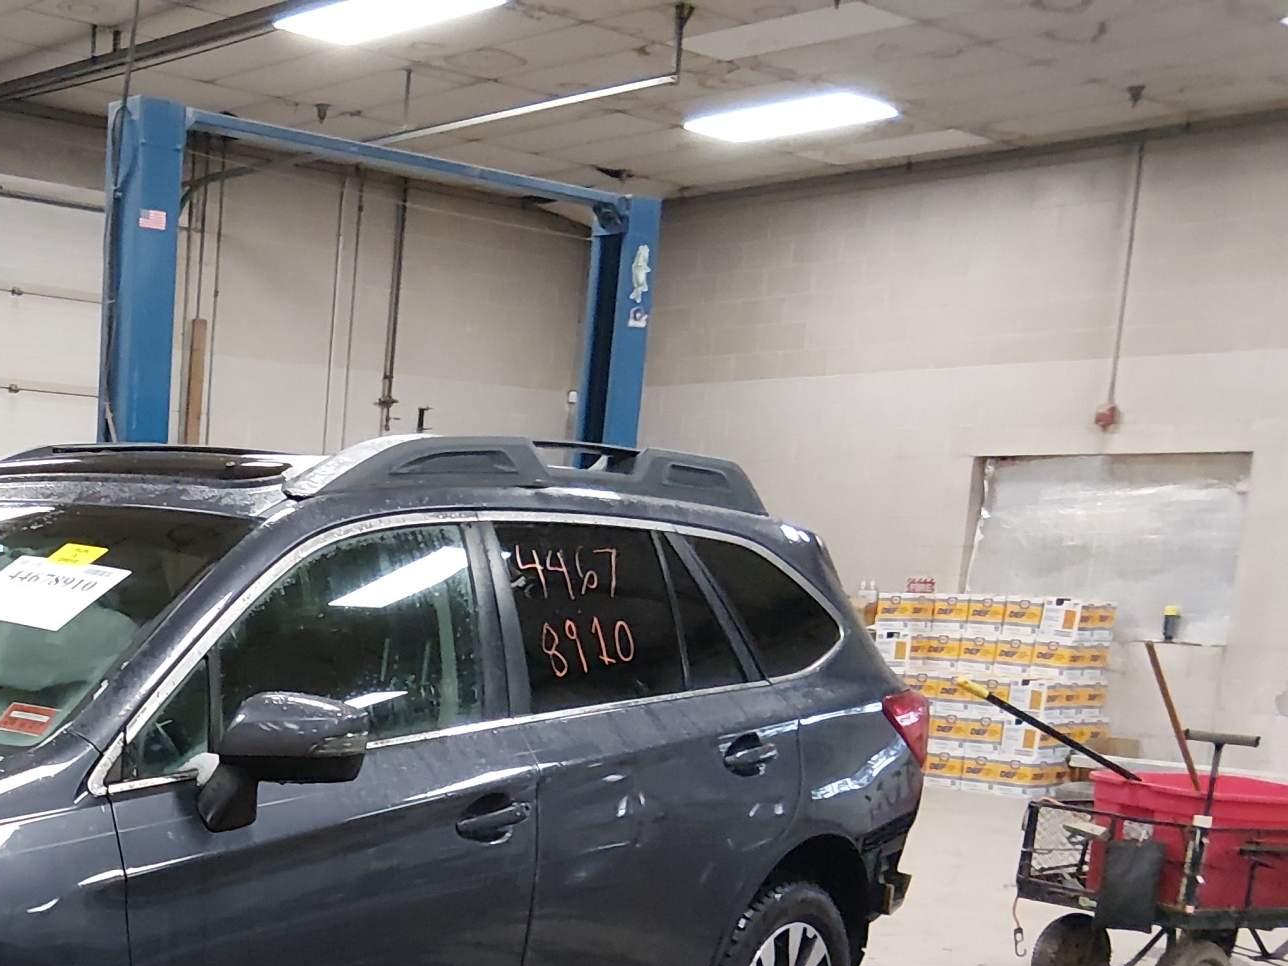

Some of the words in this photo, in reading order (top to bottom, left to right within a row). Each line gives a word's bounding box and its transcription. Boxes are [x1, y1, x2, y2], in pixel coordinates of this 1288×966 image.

[8, 570, 99, 592] 44678910
[515, 545, 617, 600] 4467
[541, 616, 635, 677] 8910
